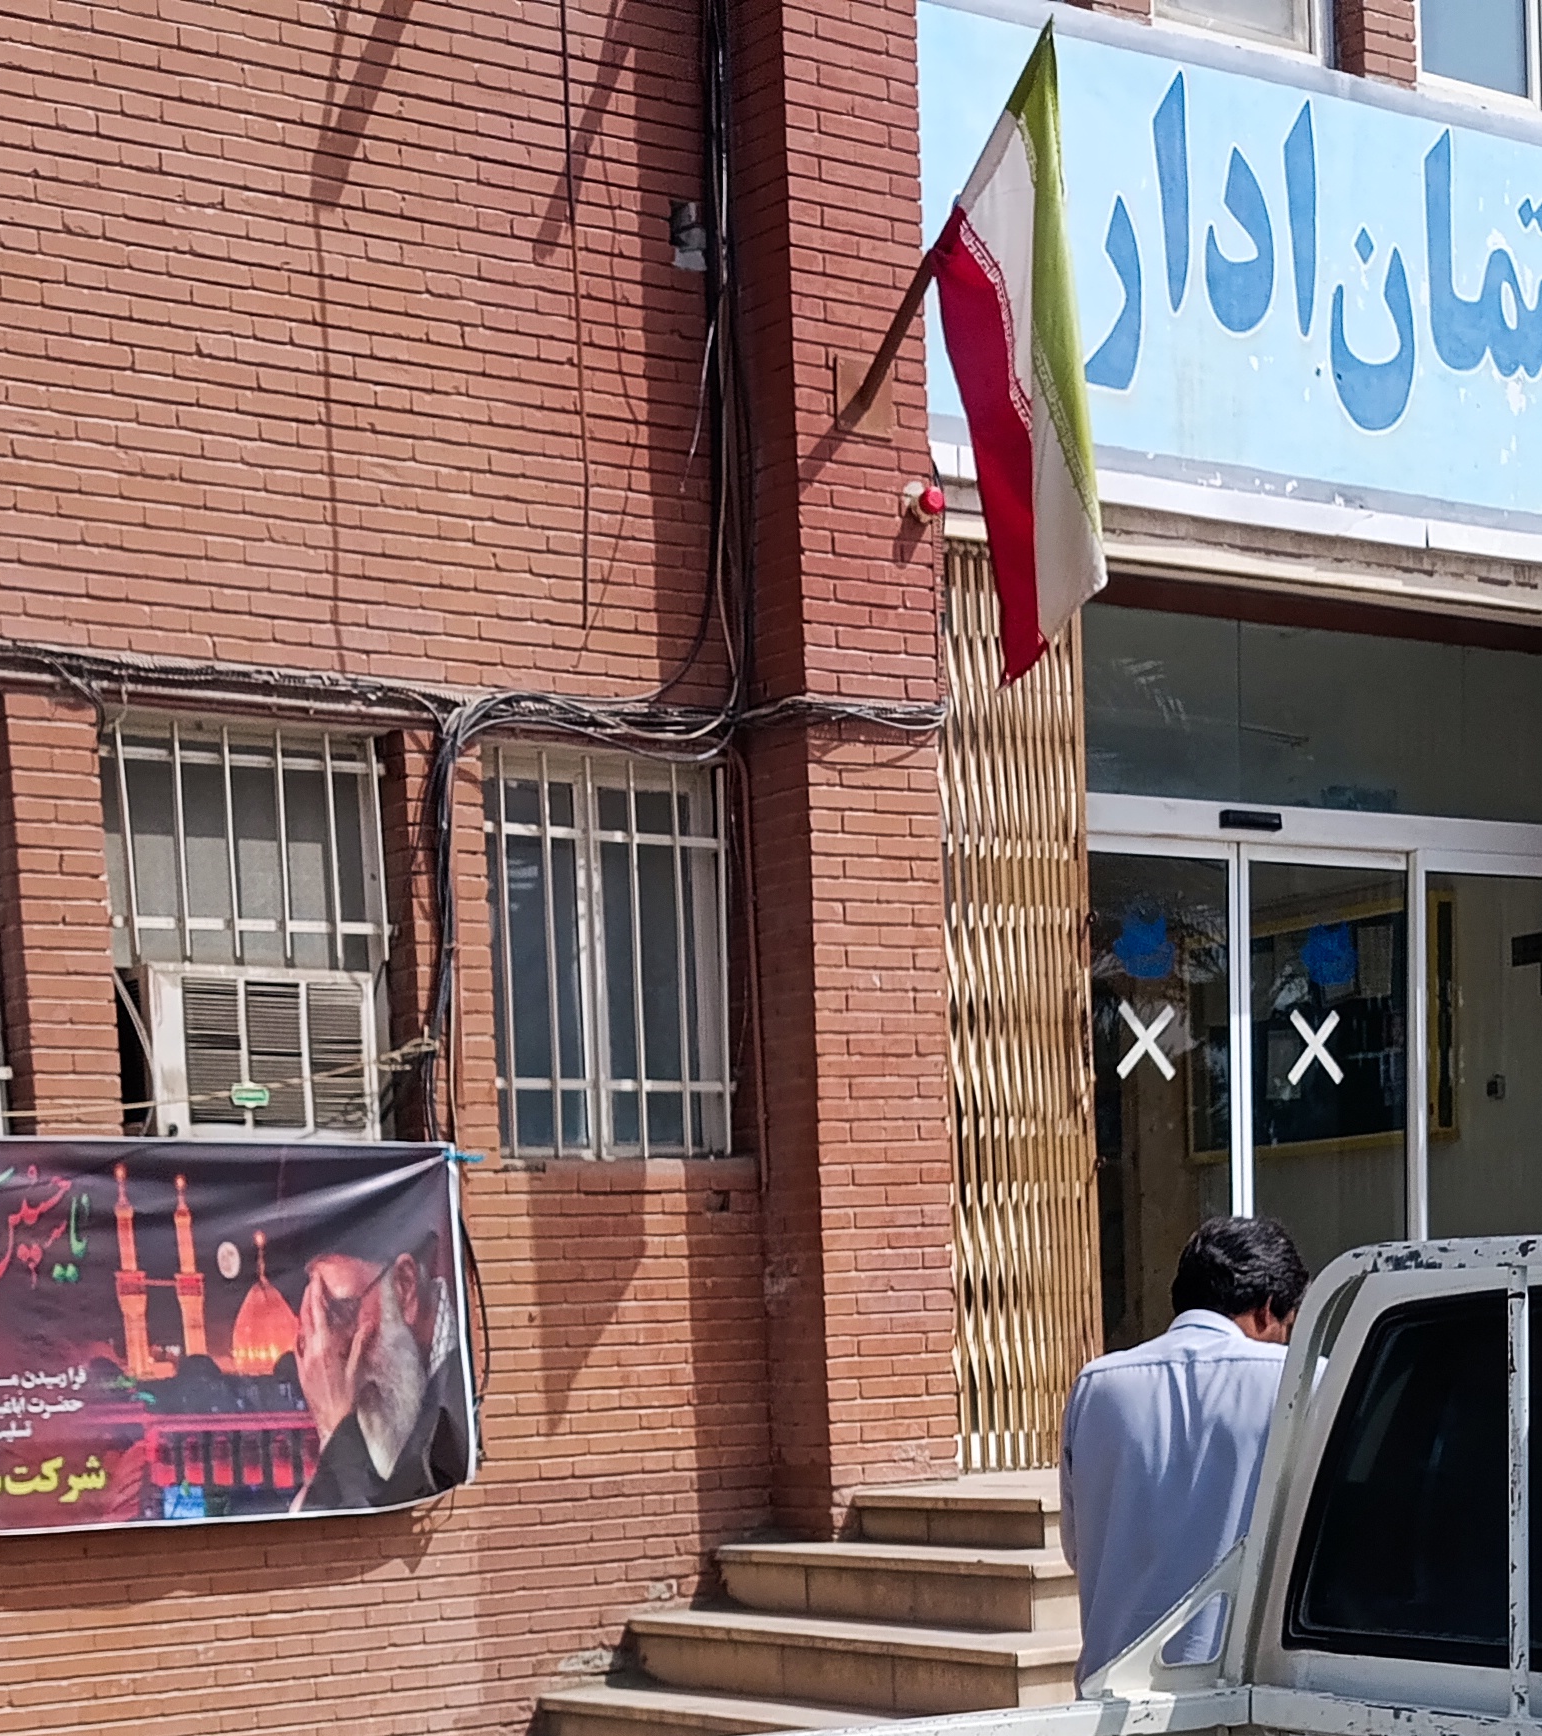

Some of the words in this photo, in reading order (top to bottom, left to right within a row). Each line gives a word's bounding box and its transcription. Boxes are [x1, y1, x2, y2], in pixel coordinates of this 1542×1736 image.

[1082, 68, 1319, 394] ادار
[26, 1396, 84, 1419] حضرت
[4, 1455, 107, 1503] شرکت
